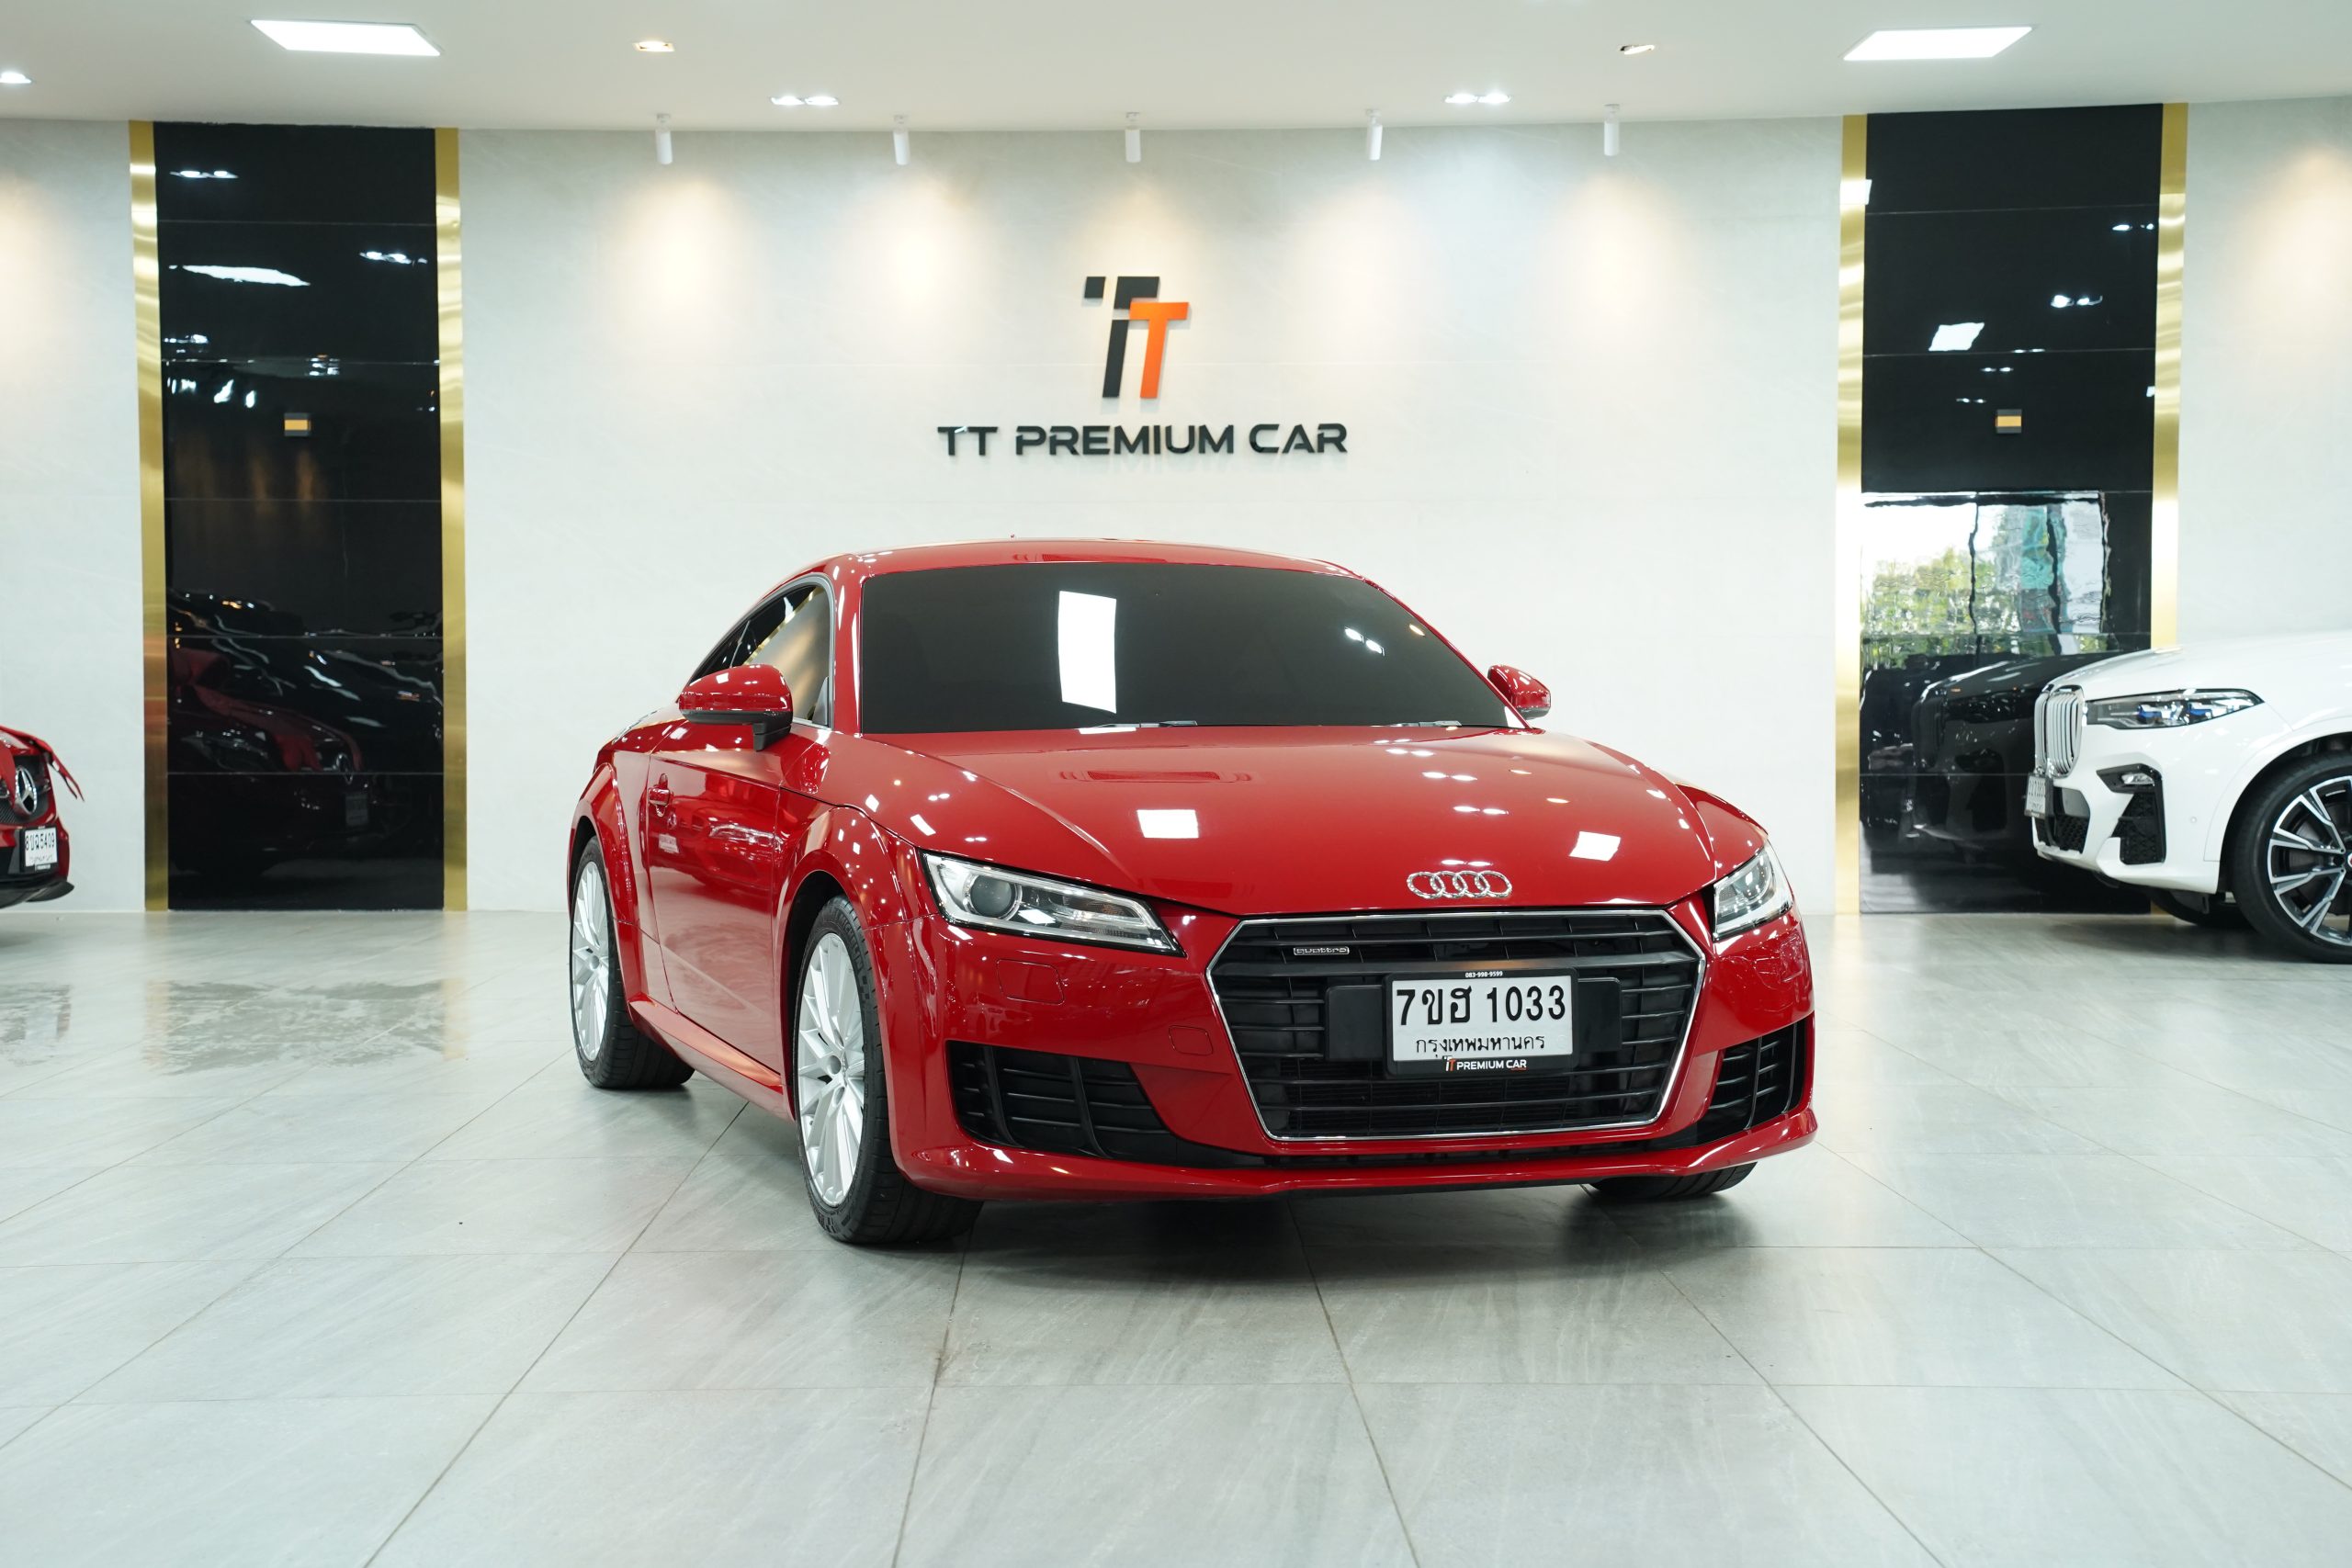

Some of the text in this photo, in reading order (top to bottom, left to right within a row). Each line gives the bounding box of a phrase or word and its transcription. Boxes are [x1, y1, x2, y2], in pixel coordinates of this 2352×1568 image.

[937, 423, 1348, 456] TT PREMIUM CAR
[1396, 985, 1566, 1025] 7ขฮ 1033
[1416, 1035, 1545, 1058] กรุงเทพมหานคร
[1456, 1060, 1504, 1071] PREMIUM
[1506, 1059, 1527, 1068] CAR
